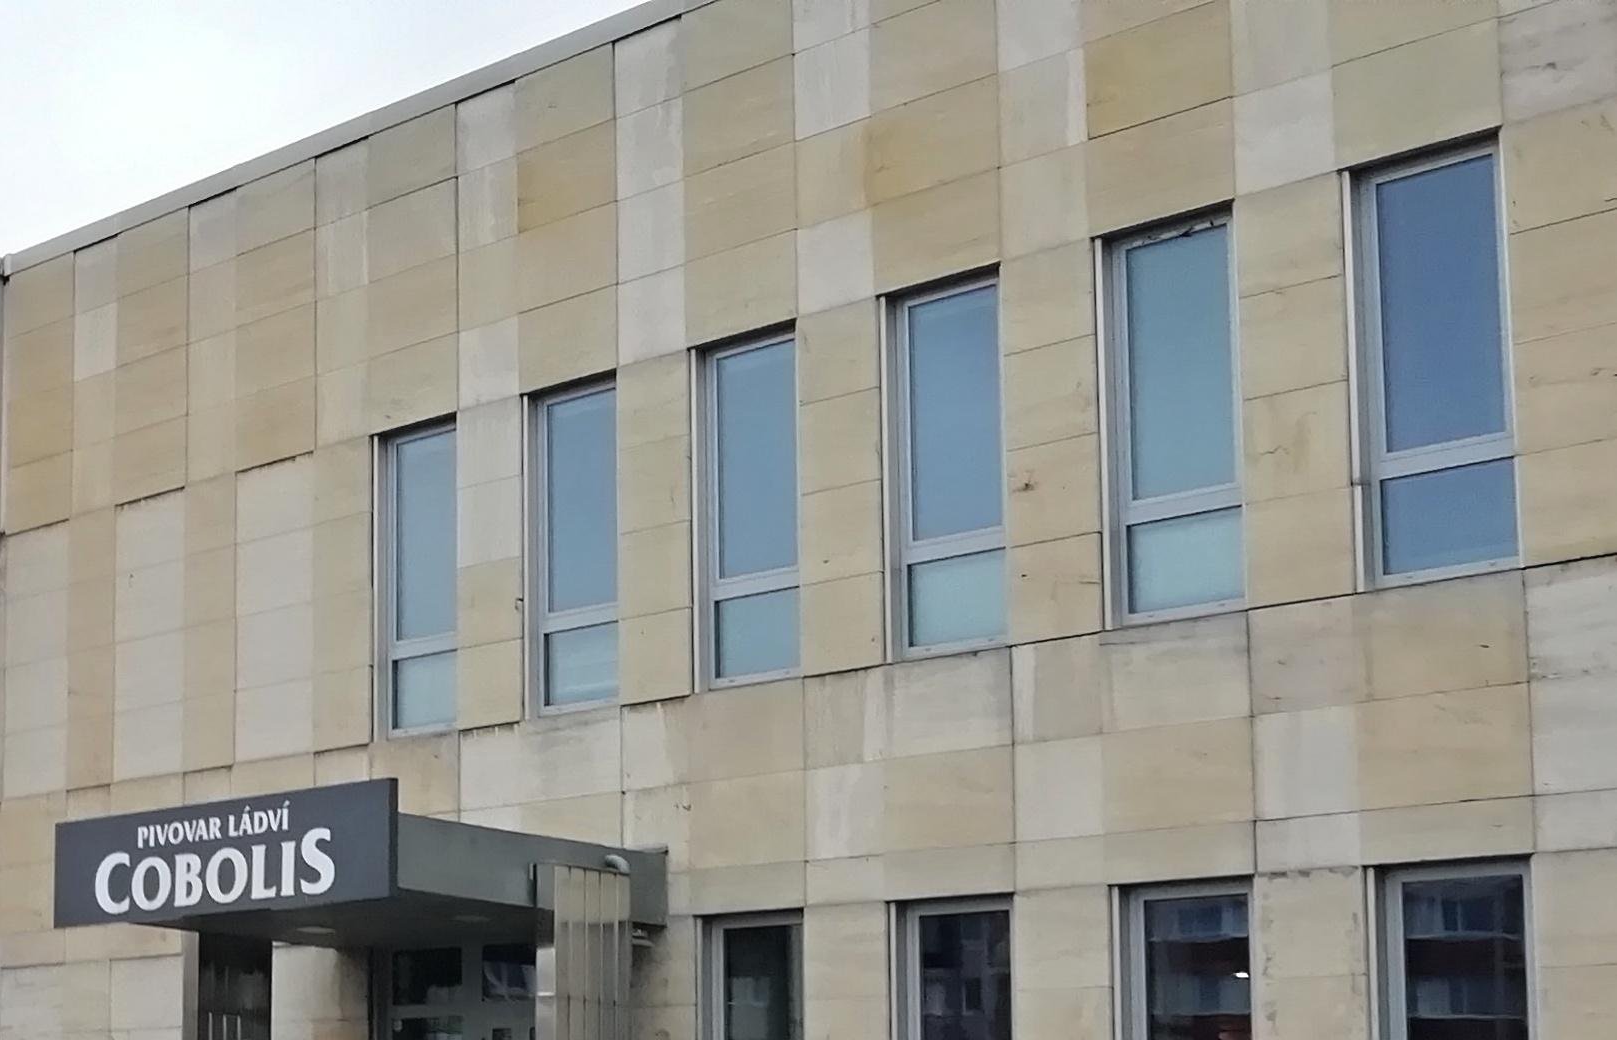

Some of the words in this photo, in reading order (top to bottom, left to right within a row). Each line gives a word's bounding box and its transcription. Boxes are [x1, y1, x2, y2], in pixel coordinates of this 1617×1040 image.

[137, 816, 222, 849] PIVOVAR
[228, 800, 291, 838] LÁDVÍ
[95, 827, 336, 915] COBOLIS
